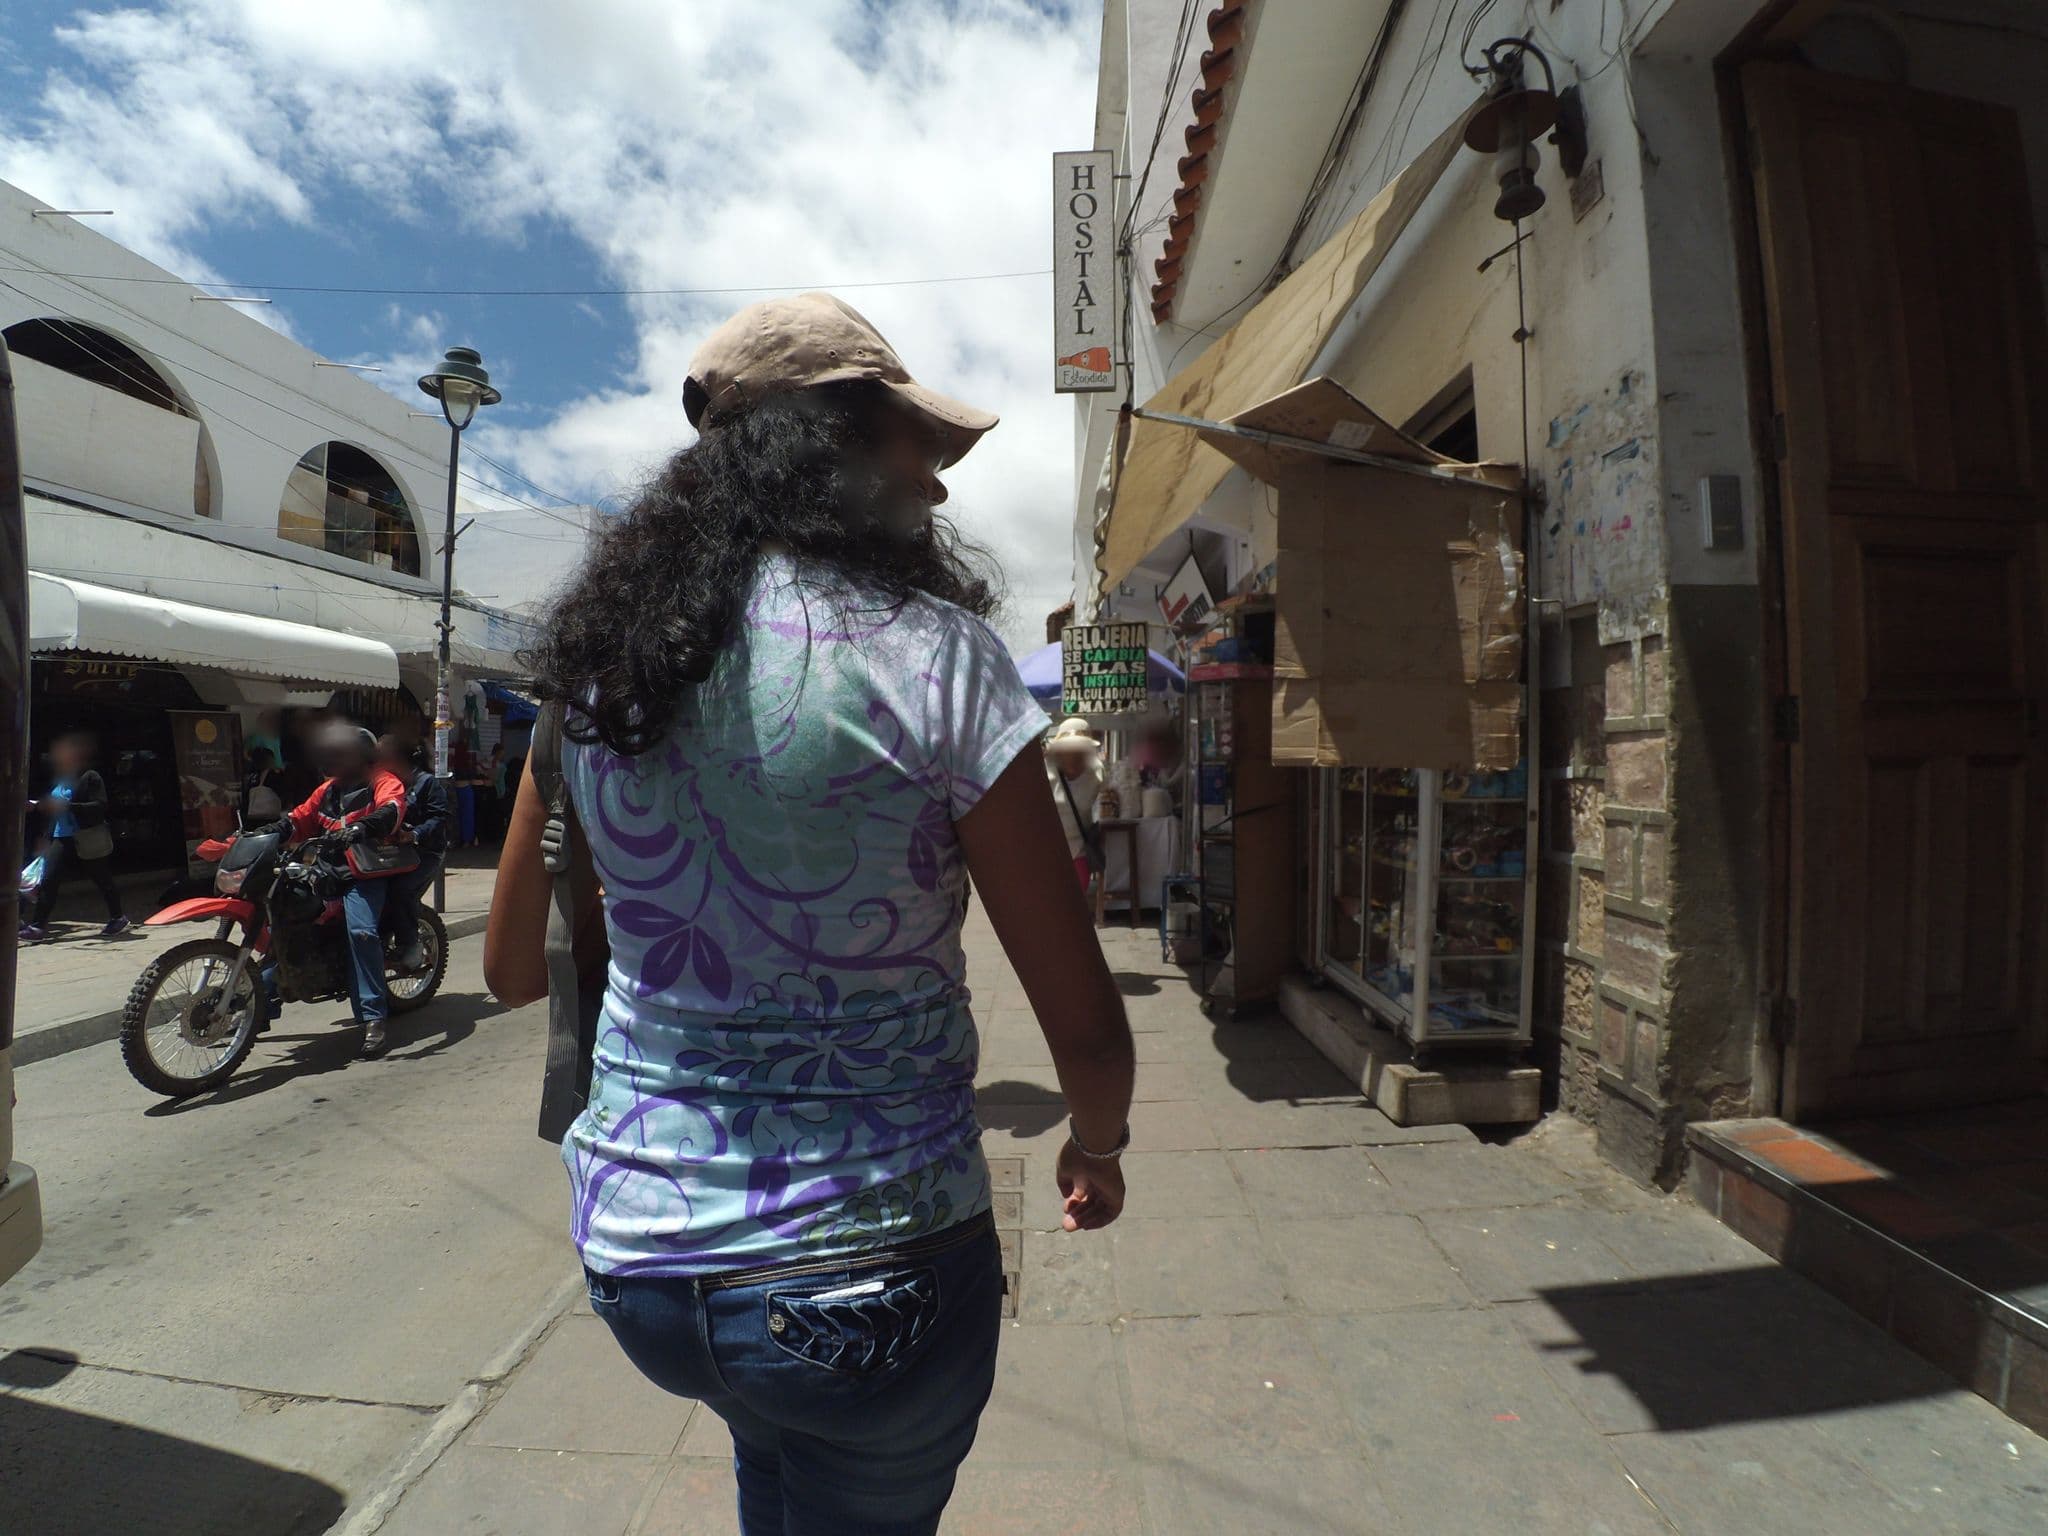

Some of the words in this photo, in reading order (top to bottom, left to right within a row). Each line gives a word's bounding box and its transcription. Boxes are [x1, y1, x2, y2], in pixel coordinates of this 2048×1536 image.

[1069, 165, 1098, 335] HOSTAL
[1063, 624, 1146, 651] RELOJERIA
[1064, 651, 1082, 663] SE
[1084, 648, 1145, 662] CAMBIA
[1065, 661, 1146, 676] PILAS
[1065, 676, 1081, 688] AL
[1084, 674, 1145, 688] INSTANTE
[1064, 686, 1146, 702] CALCULADORAS
[1064, 701, 1077, 713] Y
[1078, 700, 1148, 713] MALLAS
